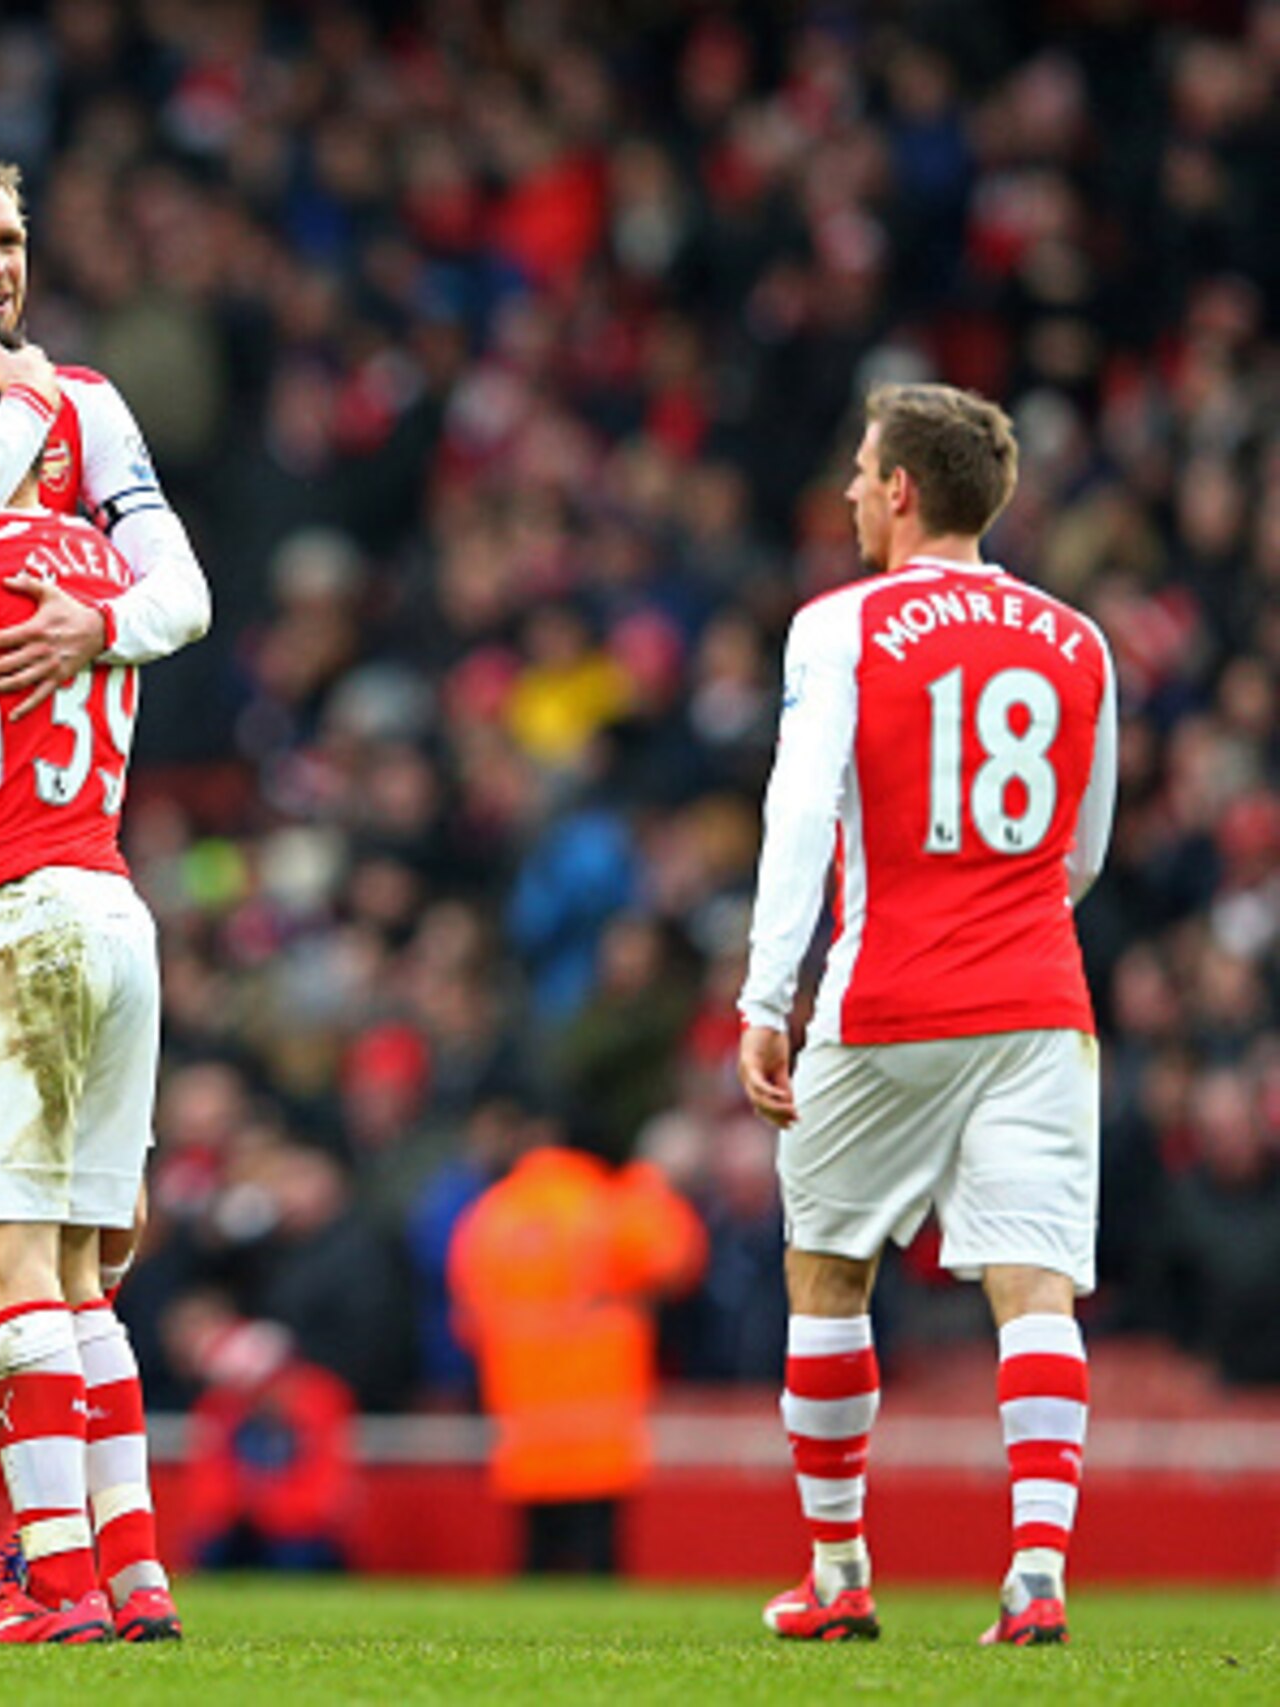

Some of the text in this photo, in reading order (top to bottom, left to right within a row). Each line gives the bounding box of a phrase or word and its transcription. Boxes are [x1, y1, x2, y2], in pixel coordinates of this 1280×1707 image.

[873, 592, 1084, 662] MONREAL
[33, 664, 140, 815] 39
[925, 667, 1060, 853] 18
